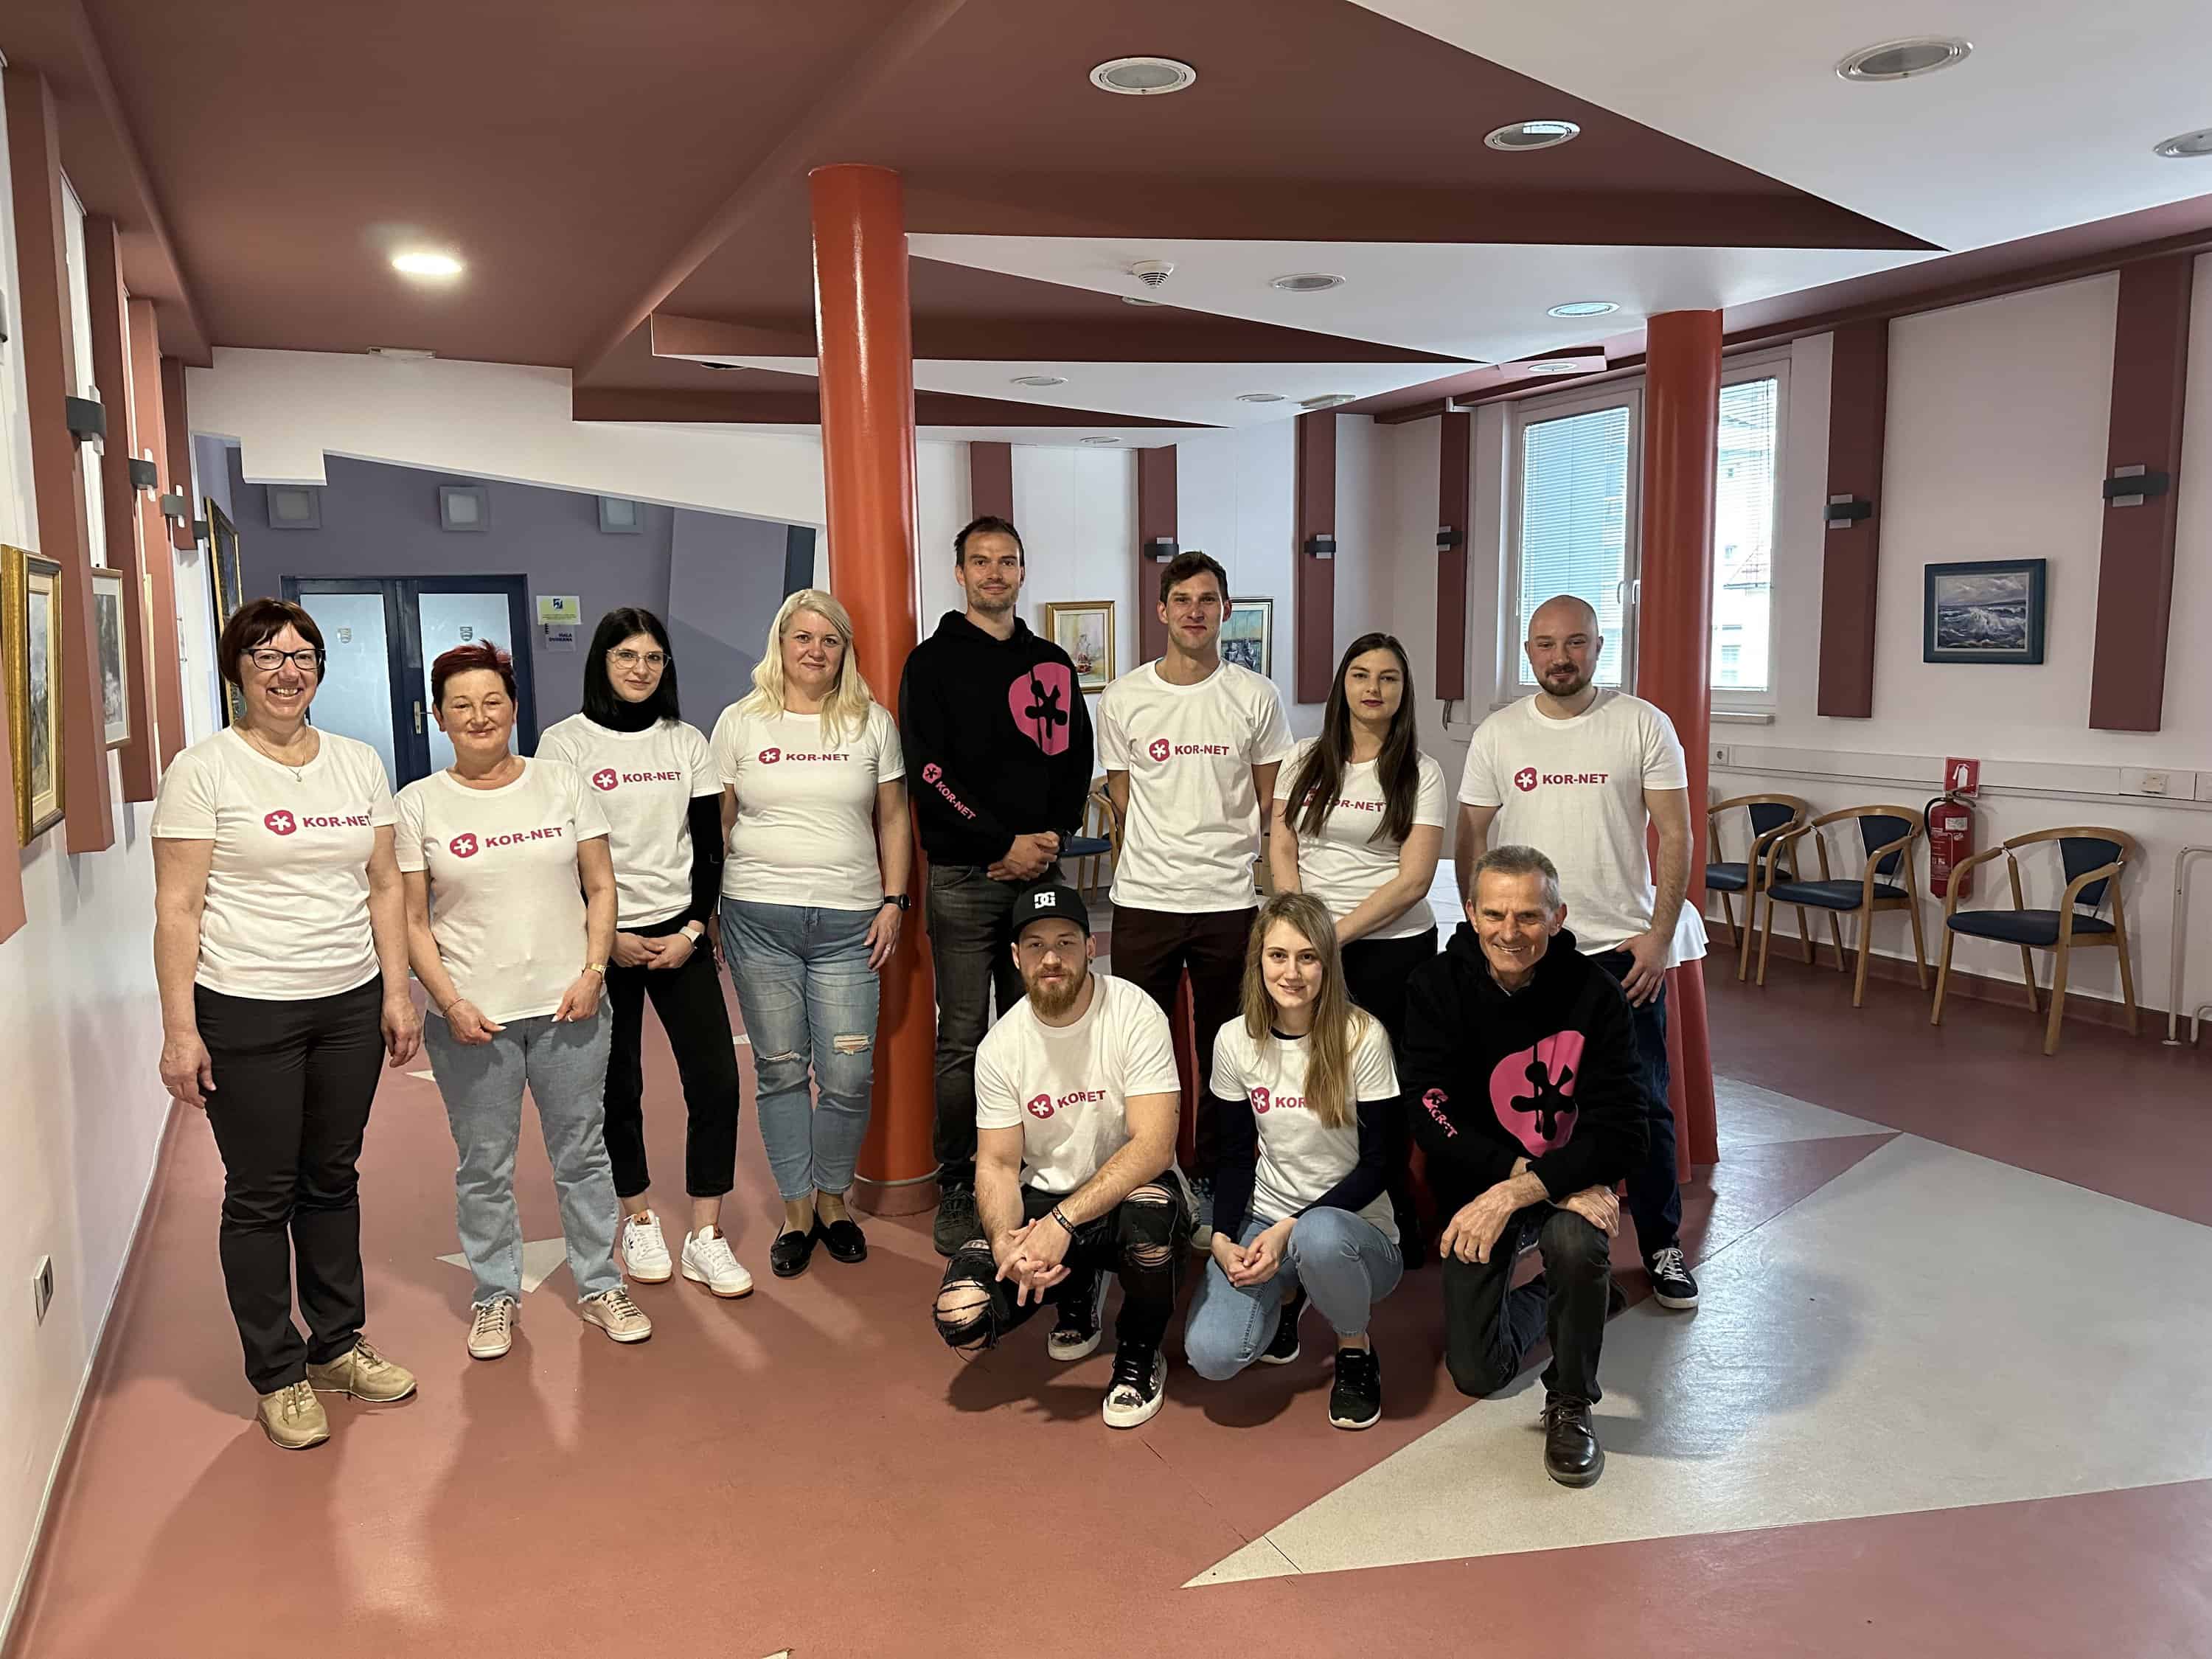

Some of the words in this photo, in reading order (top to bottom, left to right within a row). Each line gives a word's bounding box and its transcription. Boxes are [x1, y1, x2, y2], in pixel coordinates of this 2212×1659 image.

[1175, 745, 1230, 756] KOR-NET
[785, 753, 849, 762] KOR-NET
[622, 771, 681, 784] KOR-NET
[1543, 773, 1609, 785] KOR-NET
[935, 781, 976, 820] KOR-NET
[485, 827, 563, 847] KOR-NET
[1057, 1090, 1106, 1108] KORET
[1275, 1096, 1307, 1107] KOR
